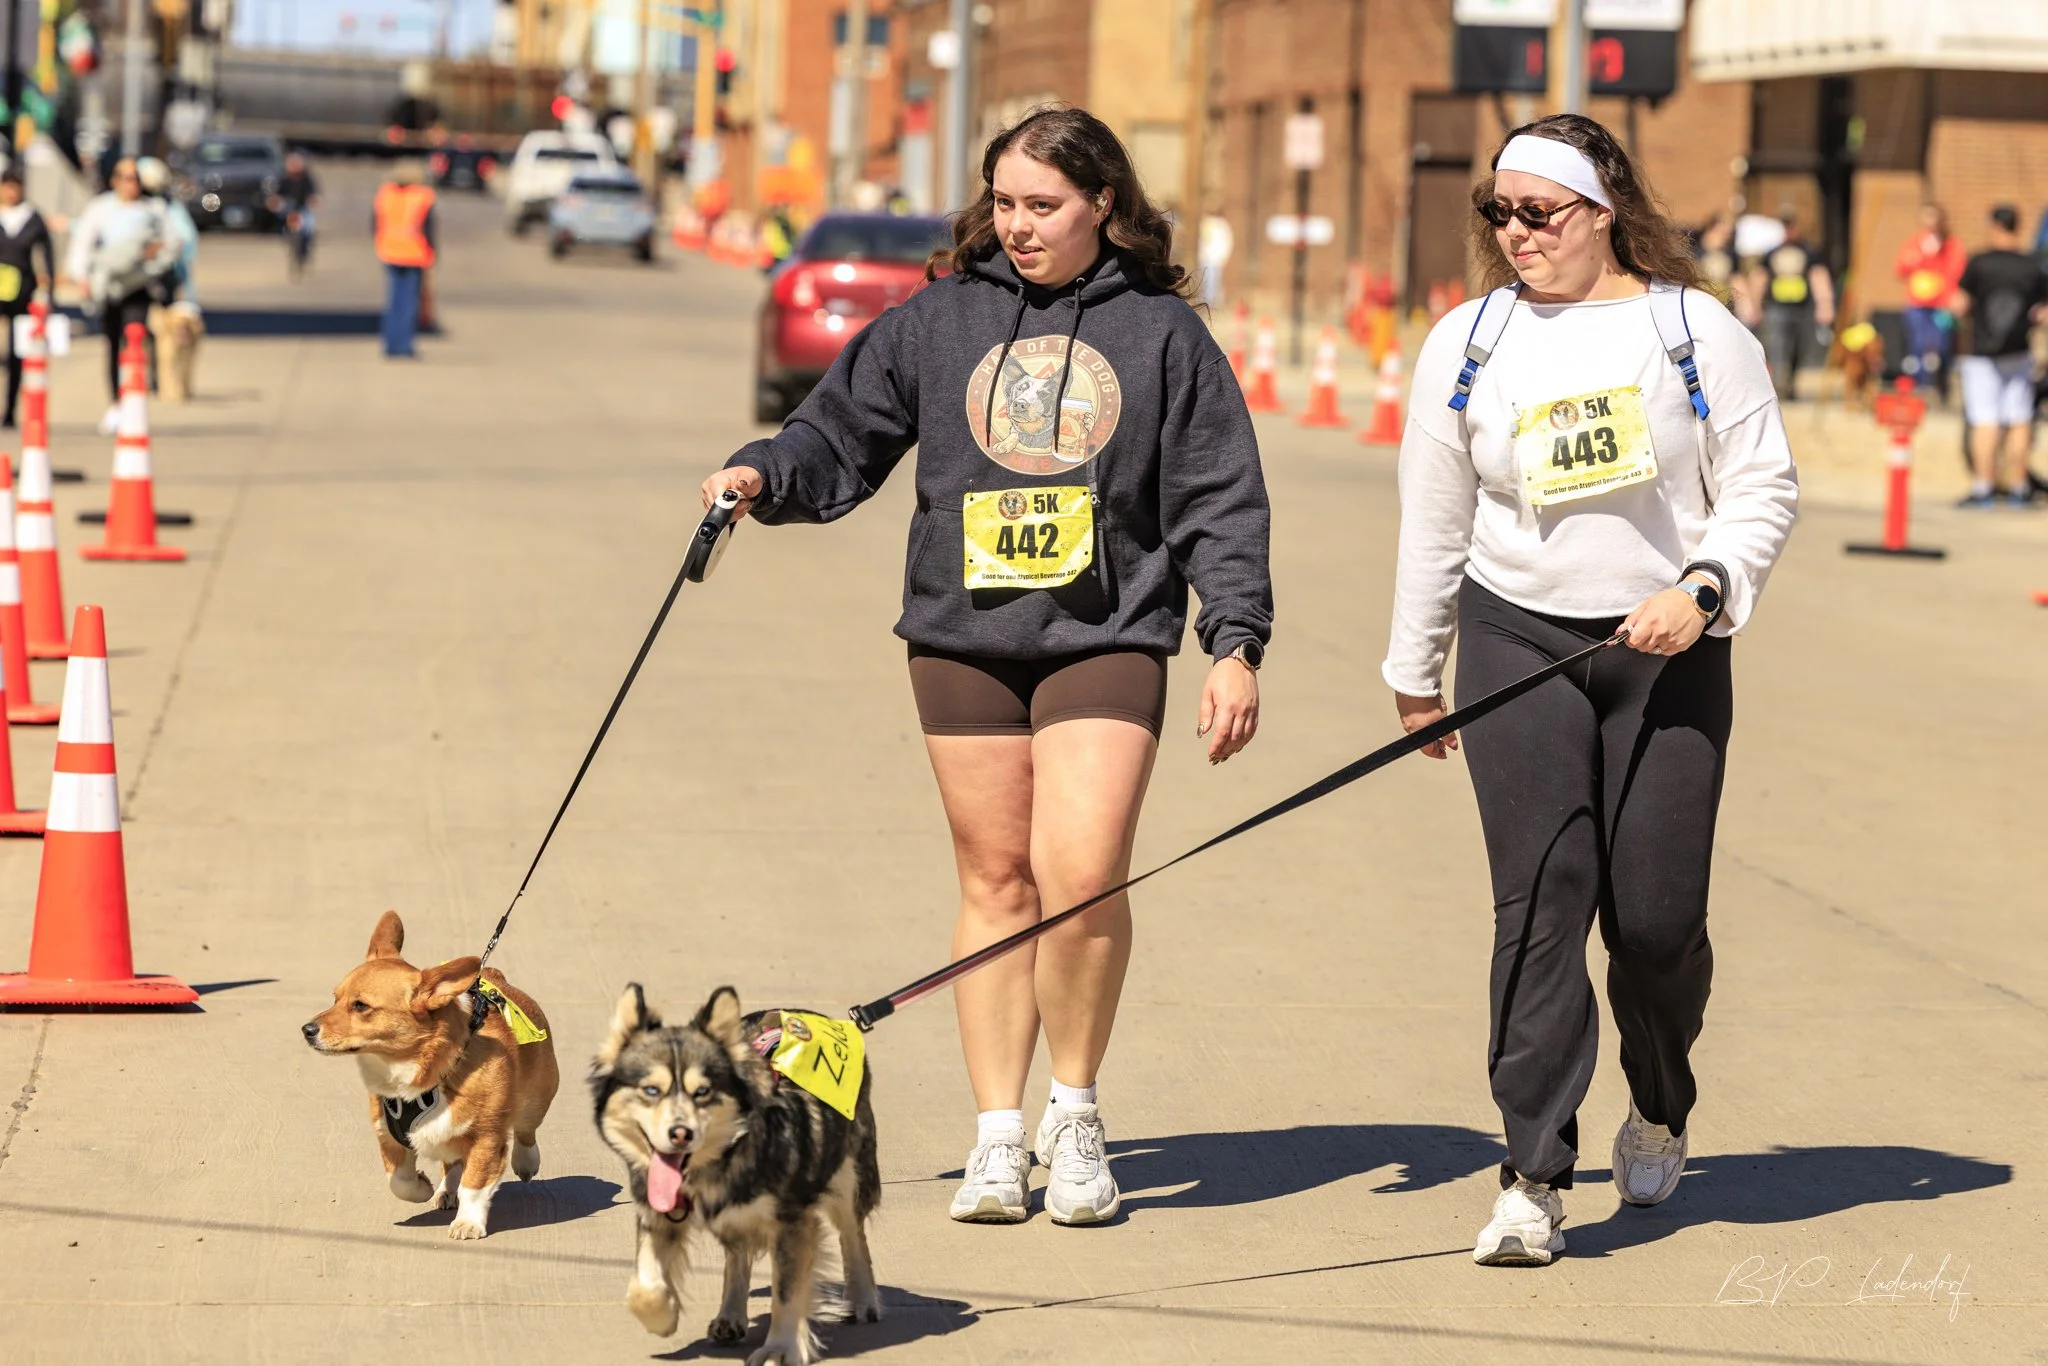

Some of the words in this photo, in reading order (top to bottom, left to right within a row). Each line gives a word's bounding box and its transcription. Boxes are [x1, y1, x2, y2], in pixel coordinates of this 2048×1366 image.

[981, 345, 1018, 375] HAR
[1027, 341, 1047, 353] OF
[1090, 361, 1116, 393] DOG
[1584, 396, 1612, 419] 5K
[1552, 427, 1619, 471] 443
[1033, 493, 1060, 514] 5K
[996, 523, 1059, 560] 442
